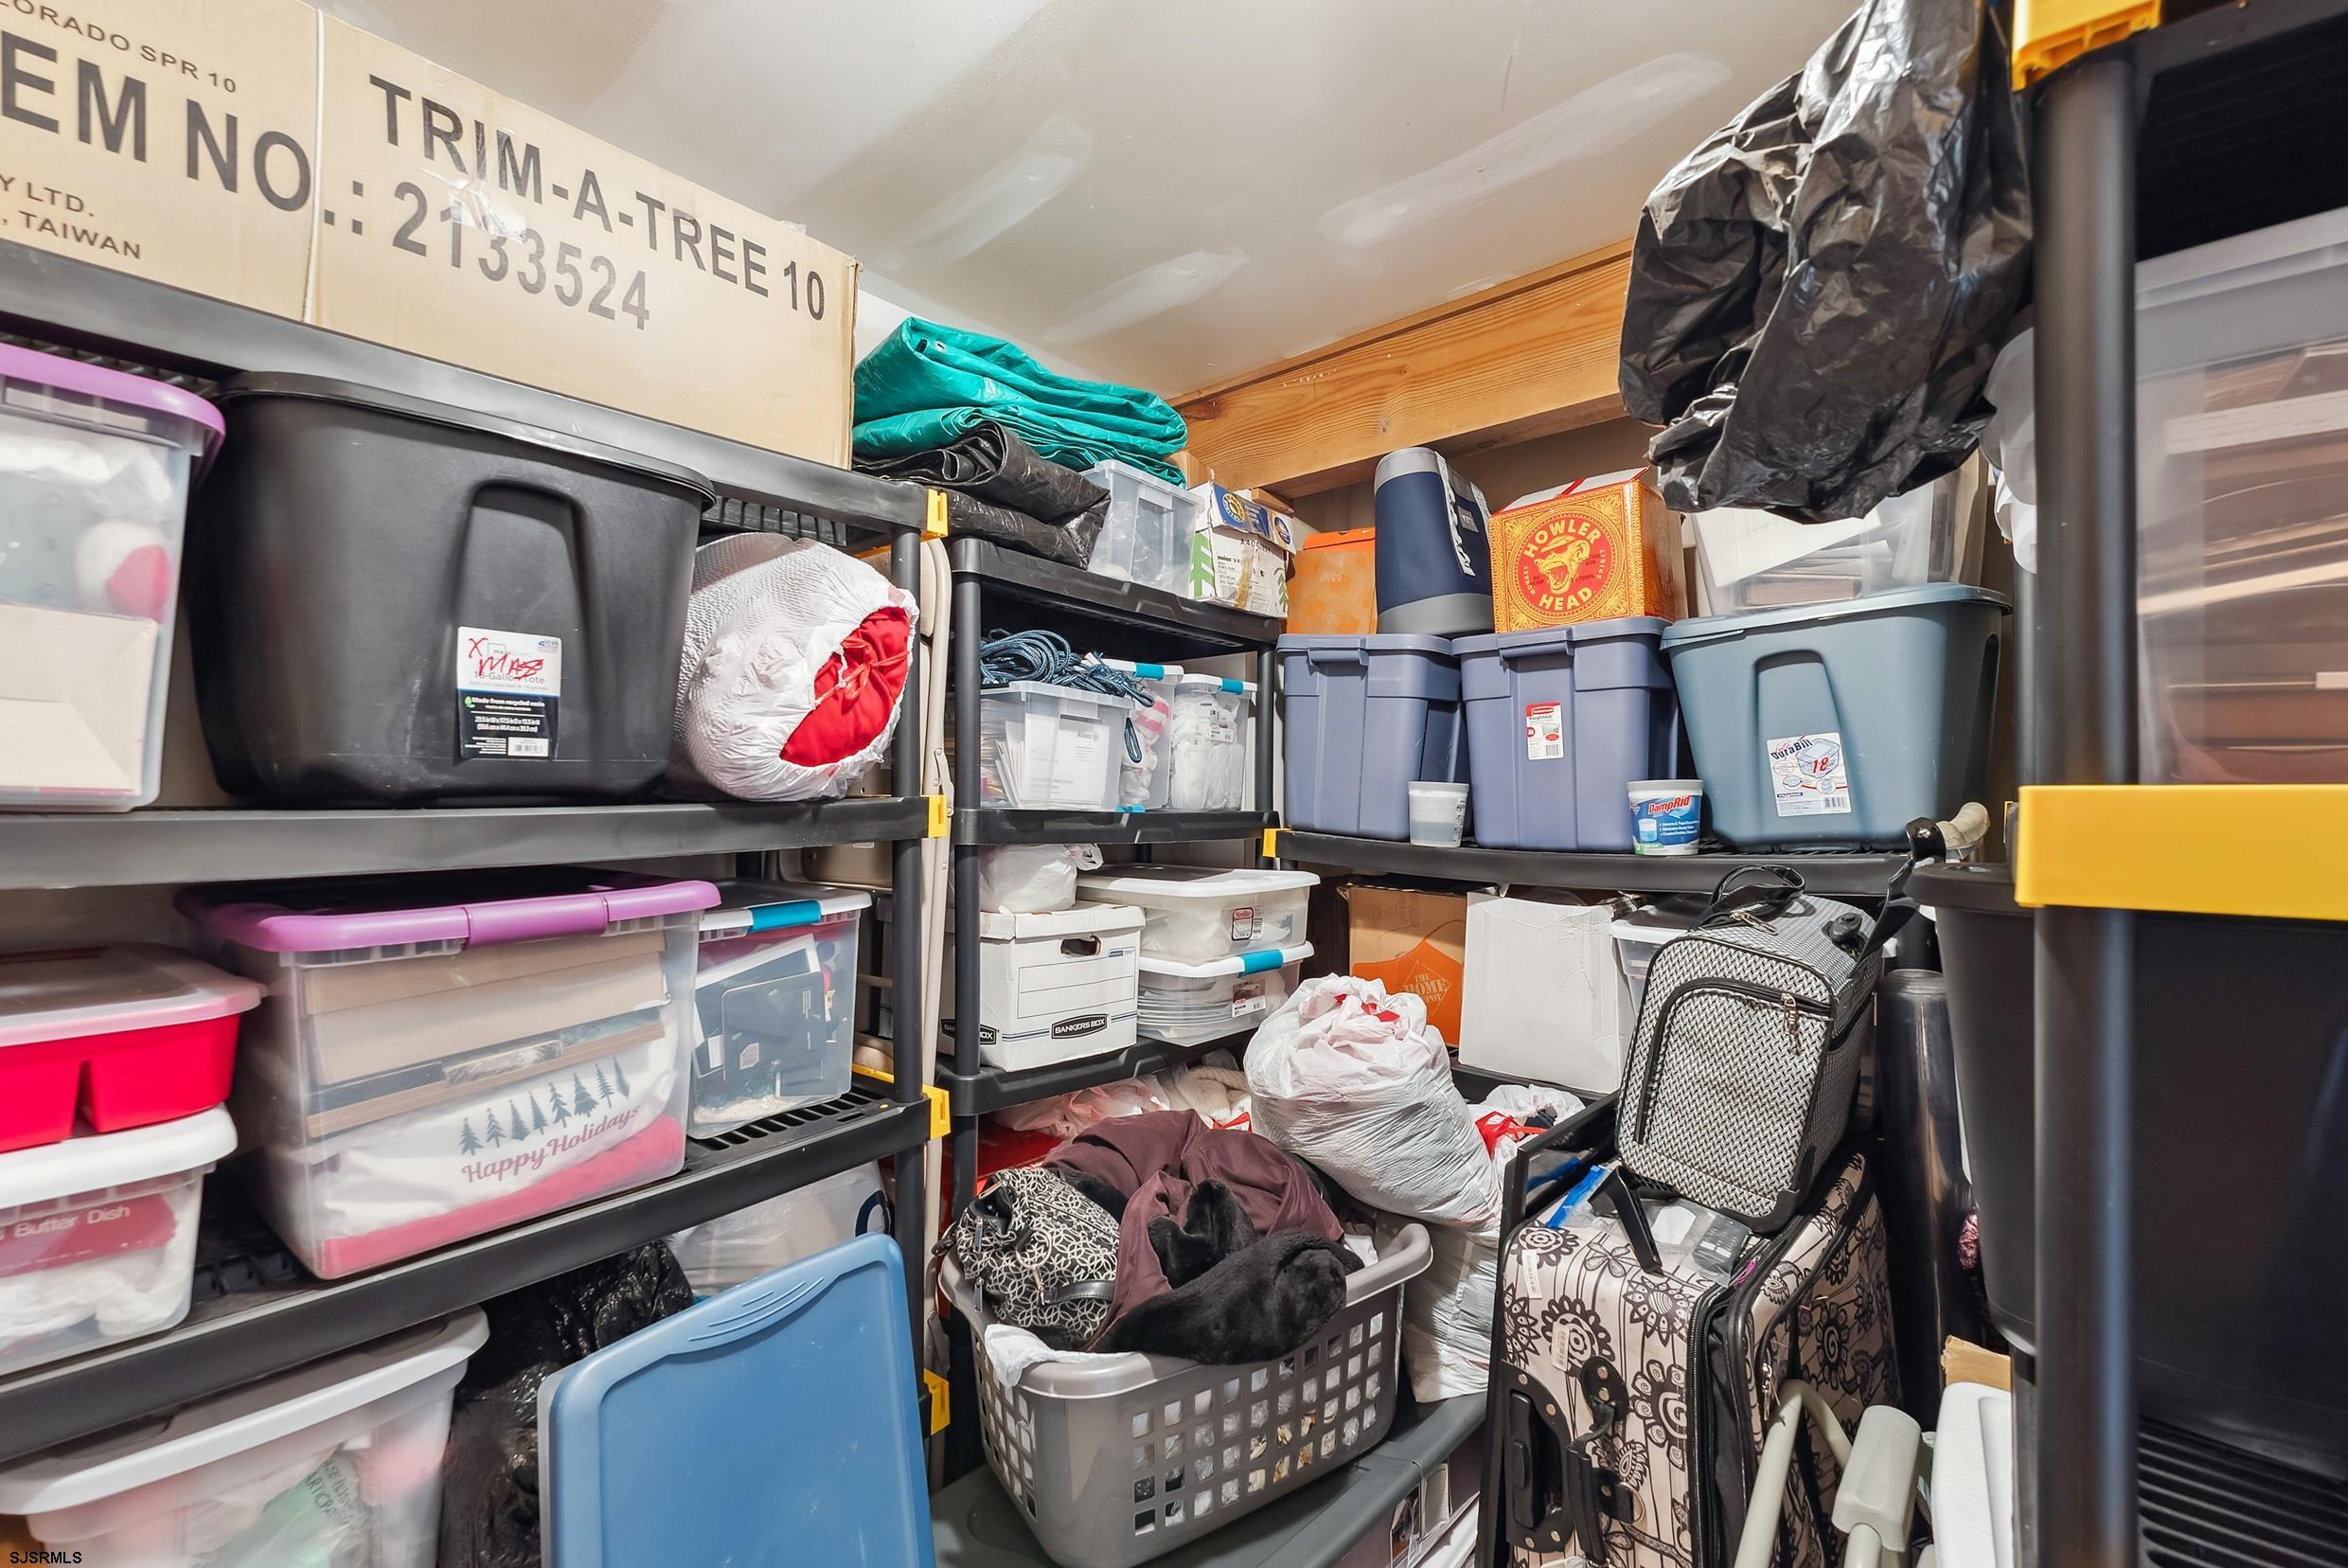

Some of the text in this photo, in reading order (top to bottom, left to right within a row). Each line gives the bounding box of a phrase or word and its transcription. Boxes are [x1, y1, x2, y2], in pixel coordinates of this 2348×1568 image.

[140, 45, 199, 80] SPR
[208, 72, 236, 94] 10
[1, 30, 147, 163] EM
[27, 182, 95, 217] LTD.
[369, 73, 825, 321] TRIM-A-TREE 10
[18, 209, 140, 260] TAIWAN
[392, 181, 650, 330] 2133524
[1523, 518, 1602, 559] HOWLER
[1538, 587, 1592, 612] HEAD
[1648, 794, 1692, 814] DampRid
[1054, 1019, 1106, 1034] BANKERS BOX
[461, 1104, 641, 1183] Happy Holidays
[14, 1214, 79, 1238] Butter
[86, 1204, 131, 1225] Dish
